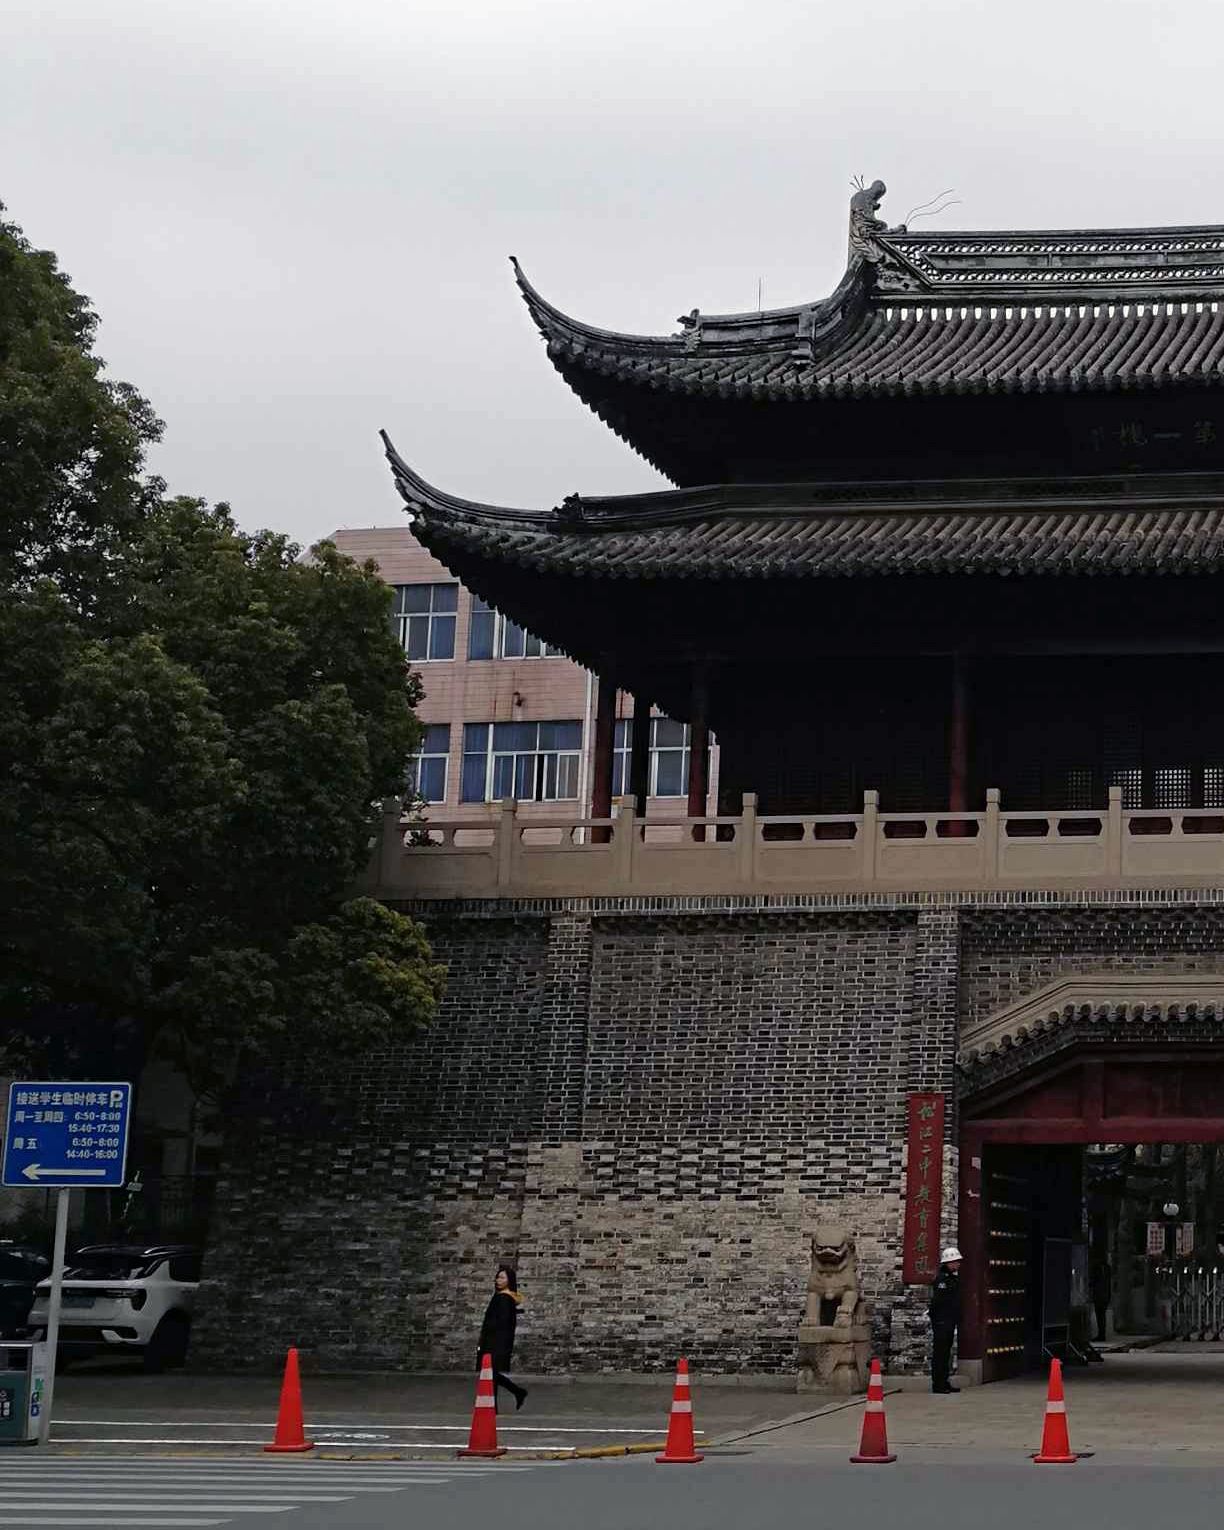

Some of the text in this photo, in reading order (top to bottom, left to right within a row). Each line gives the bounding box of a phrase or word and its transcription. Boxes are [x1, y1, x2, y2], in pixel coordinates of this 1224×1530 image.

[16, 1091, 109, 1106] 接送学生临时停车
